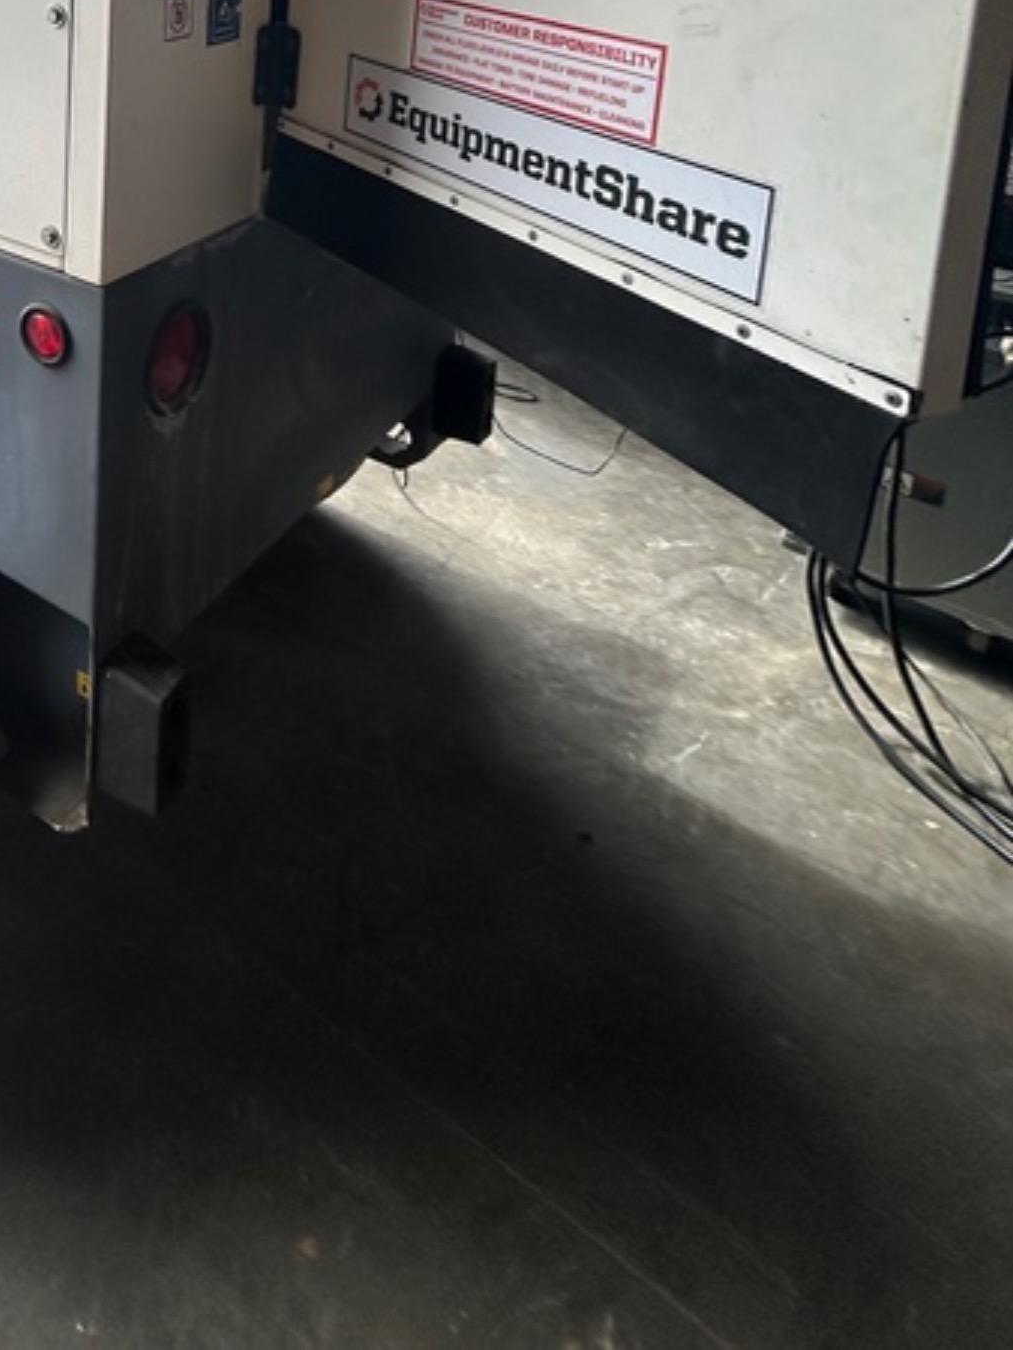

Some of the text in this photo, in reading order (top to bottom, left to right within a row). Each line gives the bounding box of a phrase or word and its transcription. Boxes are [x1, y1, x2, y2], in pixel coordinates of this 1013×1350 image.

[463, 13, 532, 40] CUSTOMER
[533, 29, 657, 70] RESPONSIBILITY
[388, 91, 751, 260] EquipmentShare
